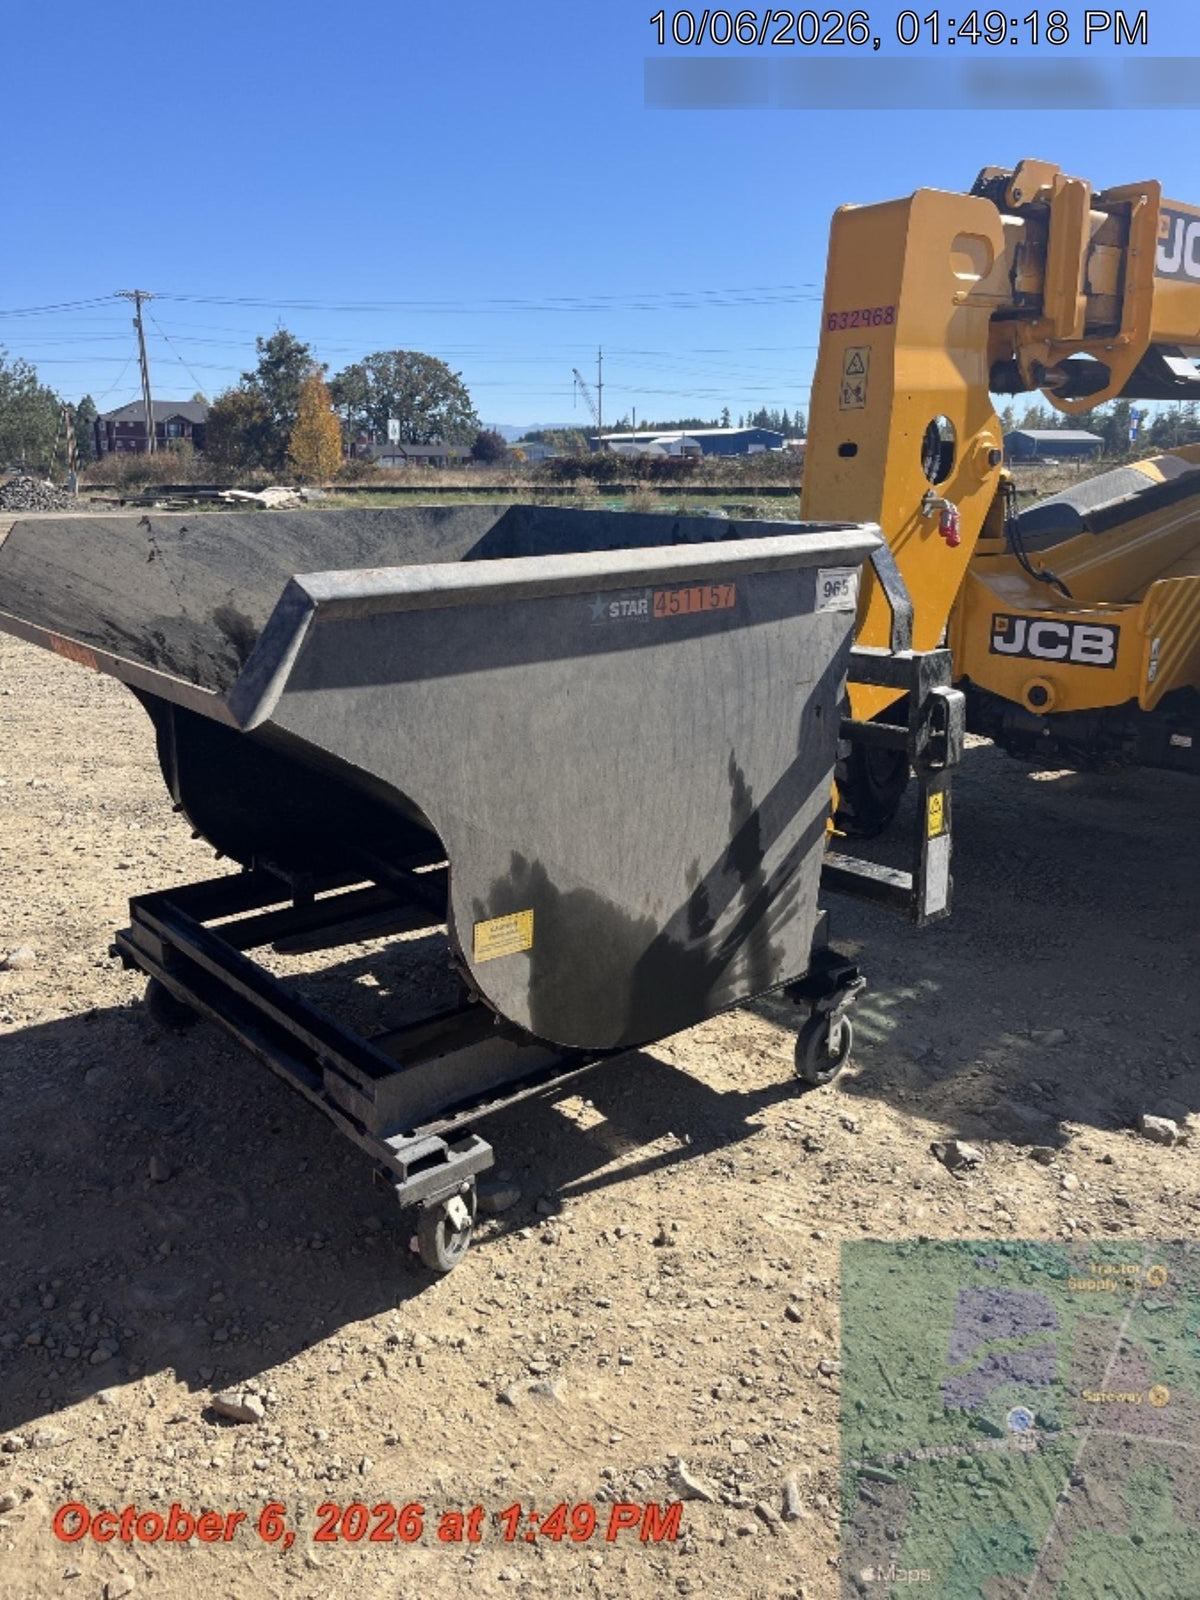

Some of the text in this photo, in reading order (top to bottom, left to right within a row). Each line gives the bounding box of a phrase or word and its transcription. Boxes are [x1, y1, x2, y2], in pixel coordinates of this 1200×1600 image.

[827, 305, 896, 332] 632968
[655, 584, 734, 616] 451157
[823, 579, 849, 598] 965
[608, 598, 649, 619] STAR
[993, 619, 1115, 665] JCB
